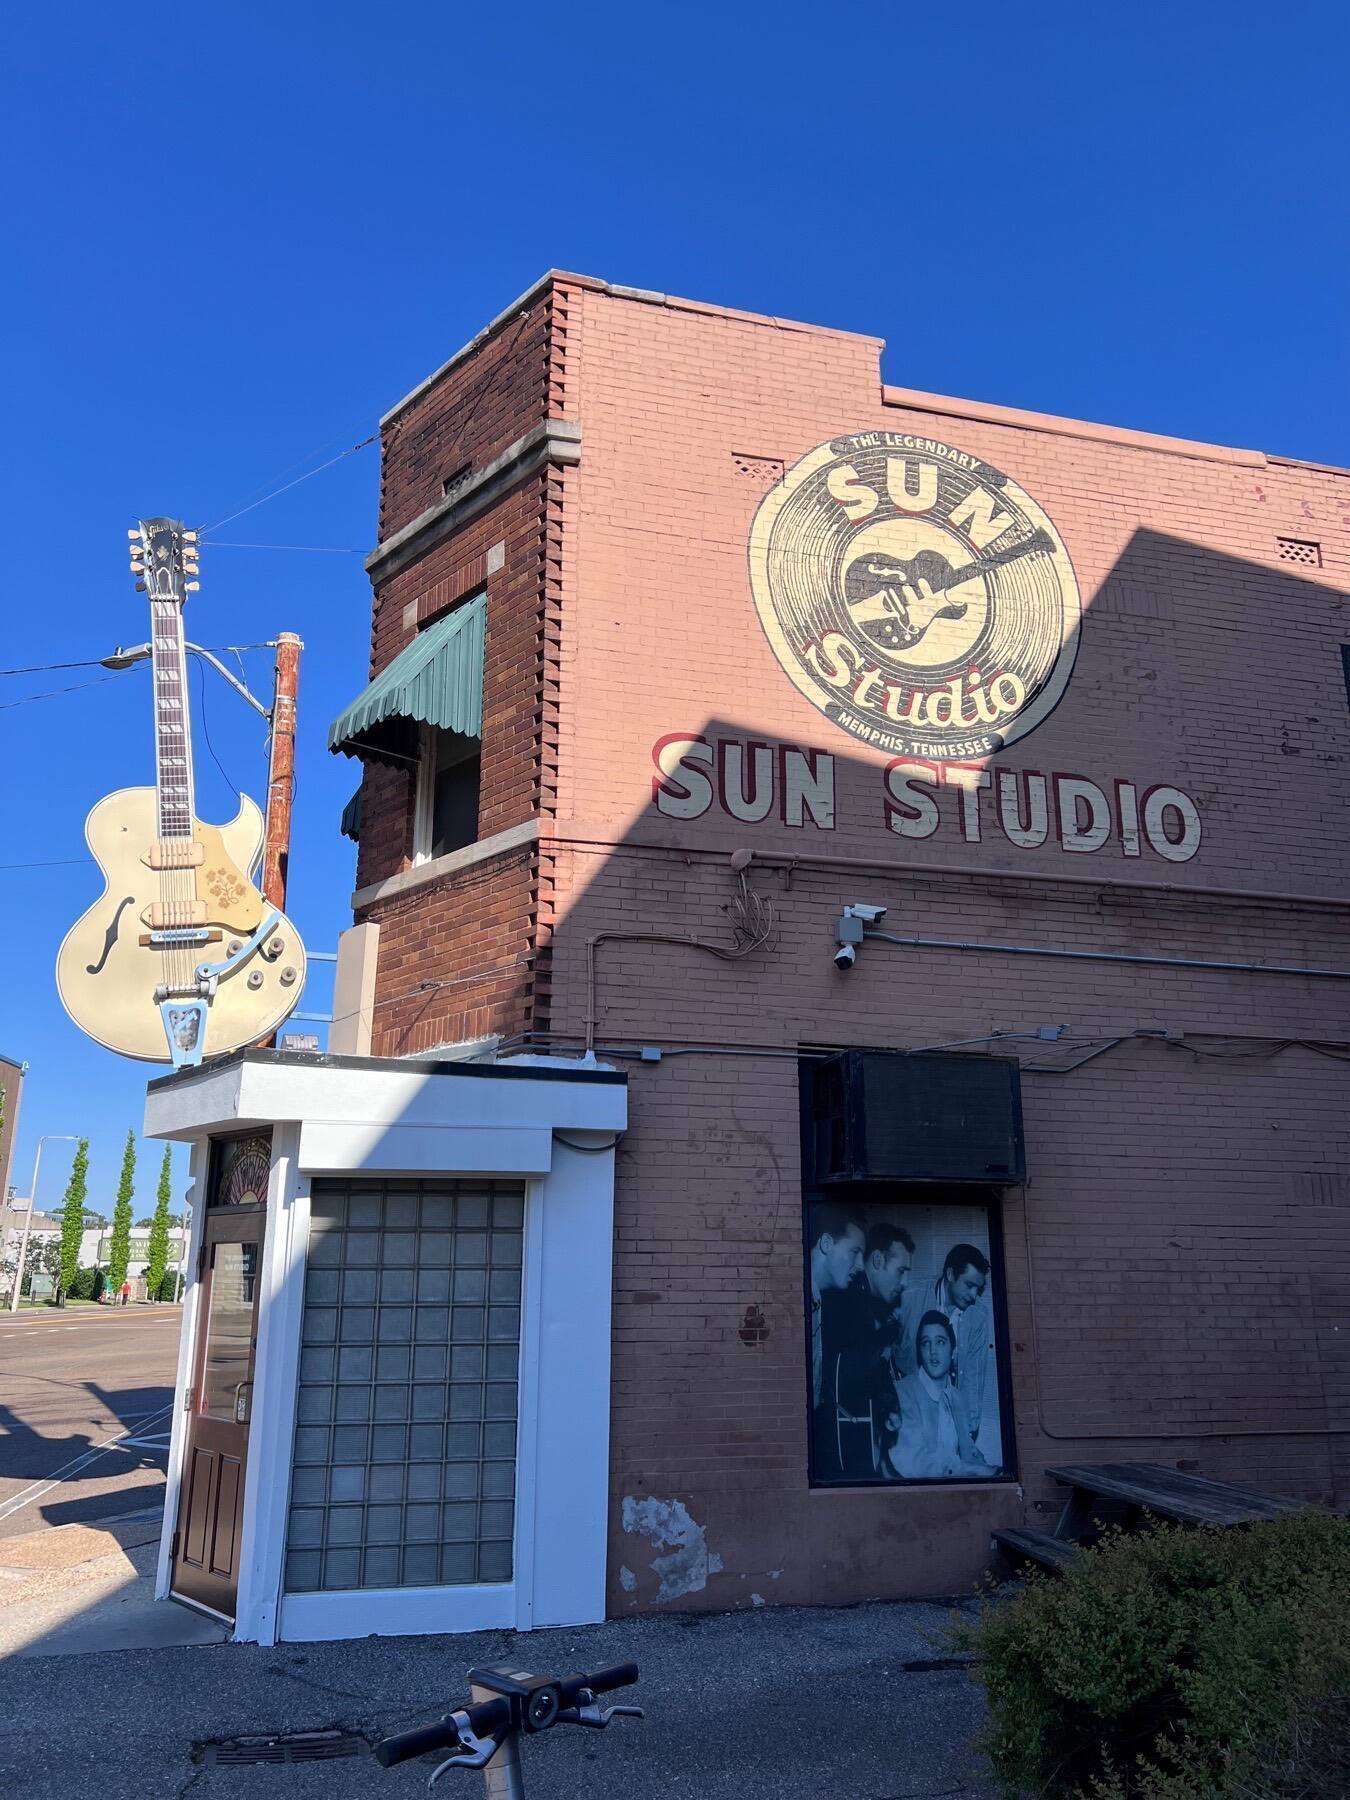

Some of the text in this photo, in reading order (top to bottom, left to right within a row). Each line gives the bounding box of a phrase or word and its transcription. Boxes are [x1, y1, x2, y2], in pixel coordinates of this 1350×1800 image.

[850, 432, 982, 471] THE LEGENDARY
[827, 457, 1016, 551] SUN
[802, 628, 1026, 728] Studio
[911, 737, 992, 756] TENNESSEE
[651, 732, 1202, 864] SUN STUDIO
